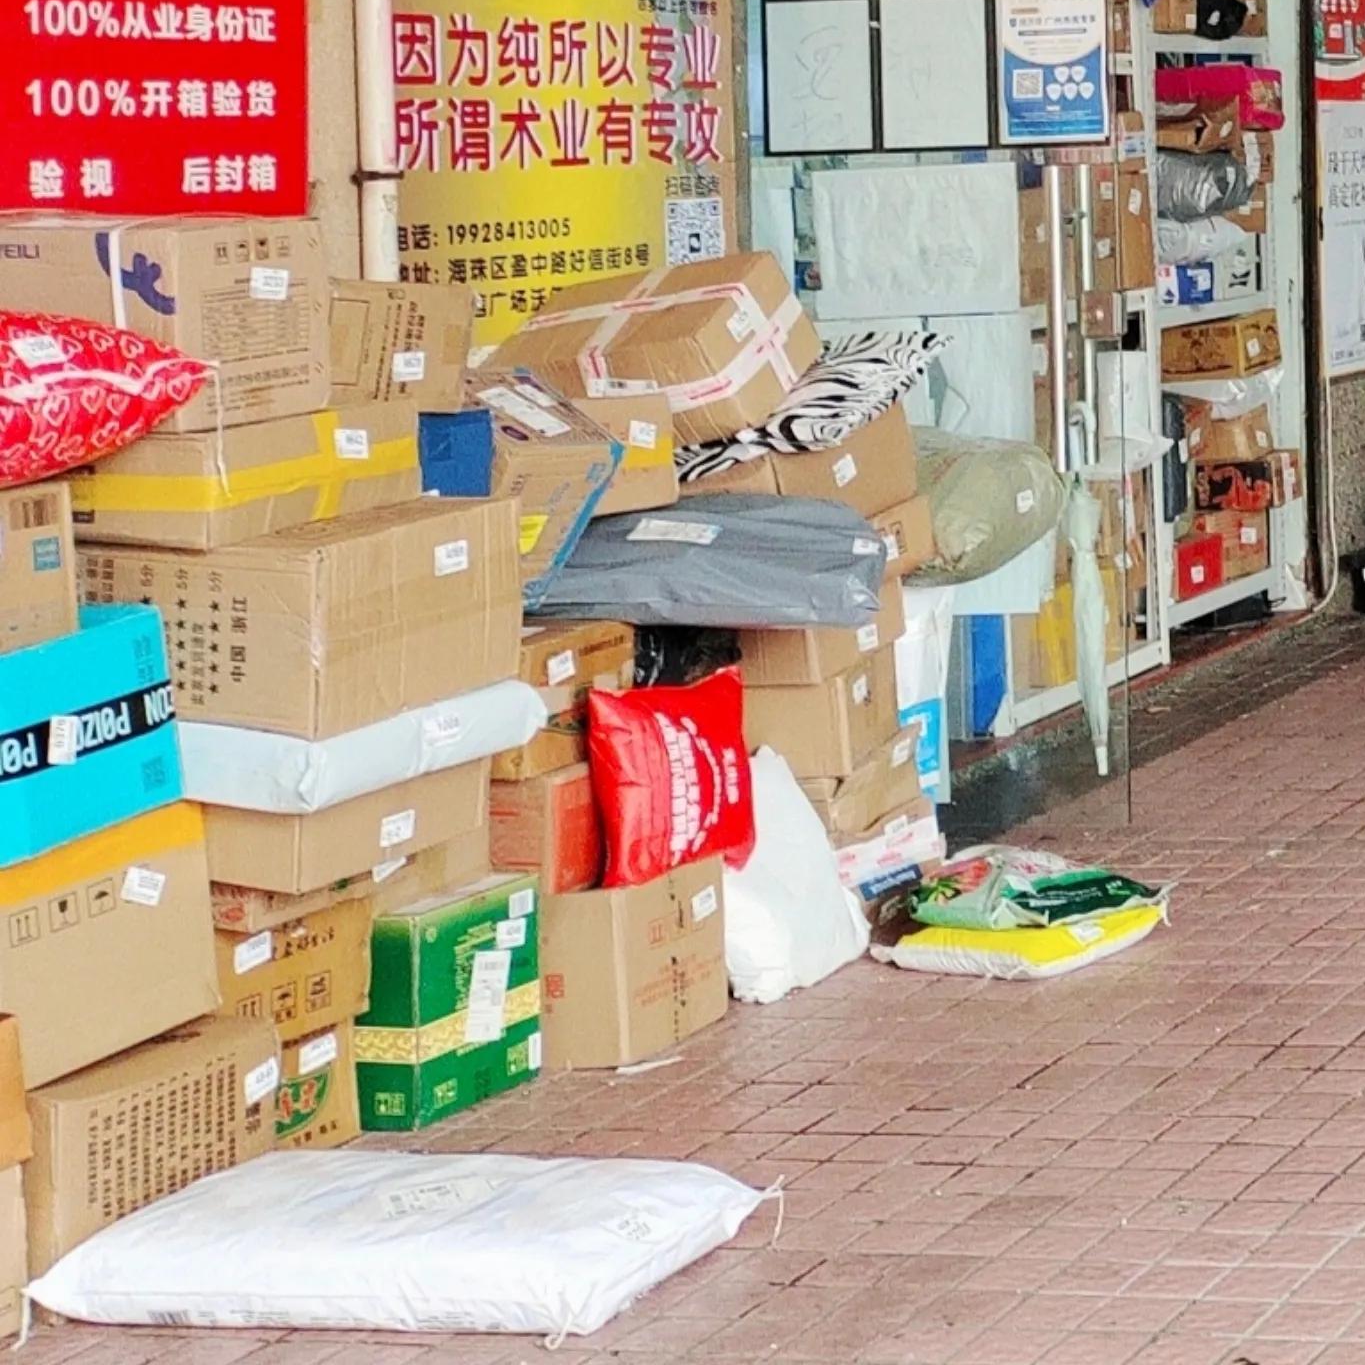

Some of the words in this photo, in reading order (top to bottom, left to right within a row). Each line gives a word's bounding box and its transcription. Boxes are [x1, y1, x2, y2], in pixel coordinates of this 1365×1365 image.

[393, 11, 721, 93] 因为纯所以专业
[24, 77, 277, 118] 100%开箱验货
[394, 94, 723, 175] 所谓术业有专攻
[28, 158, 115, 199] 验视
[180, 155, 278, 194] 后封箱
[446, 216, 572, 246] 19928413005
[231, 596, 248, 635] 浙江
[229, 644, 246, 683] 中国
